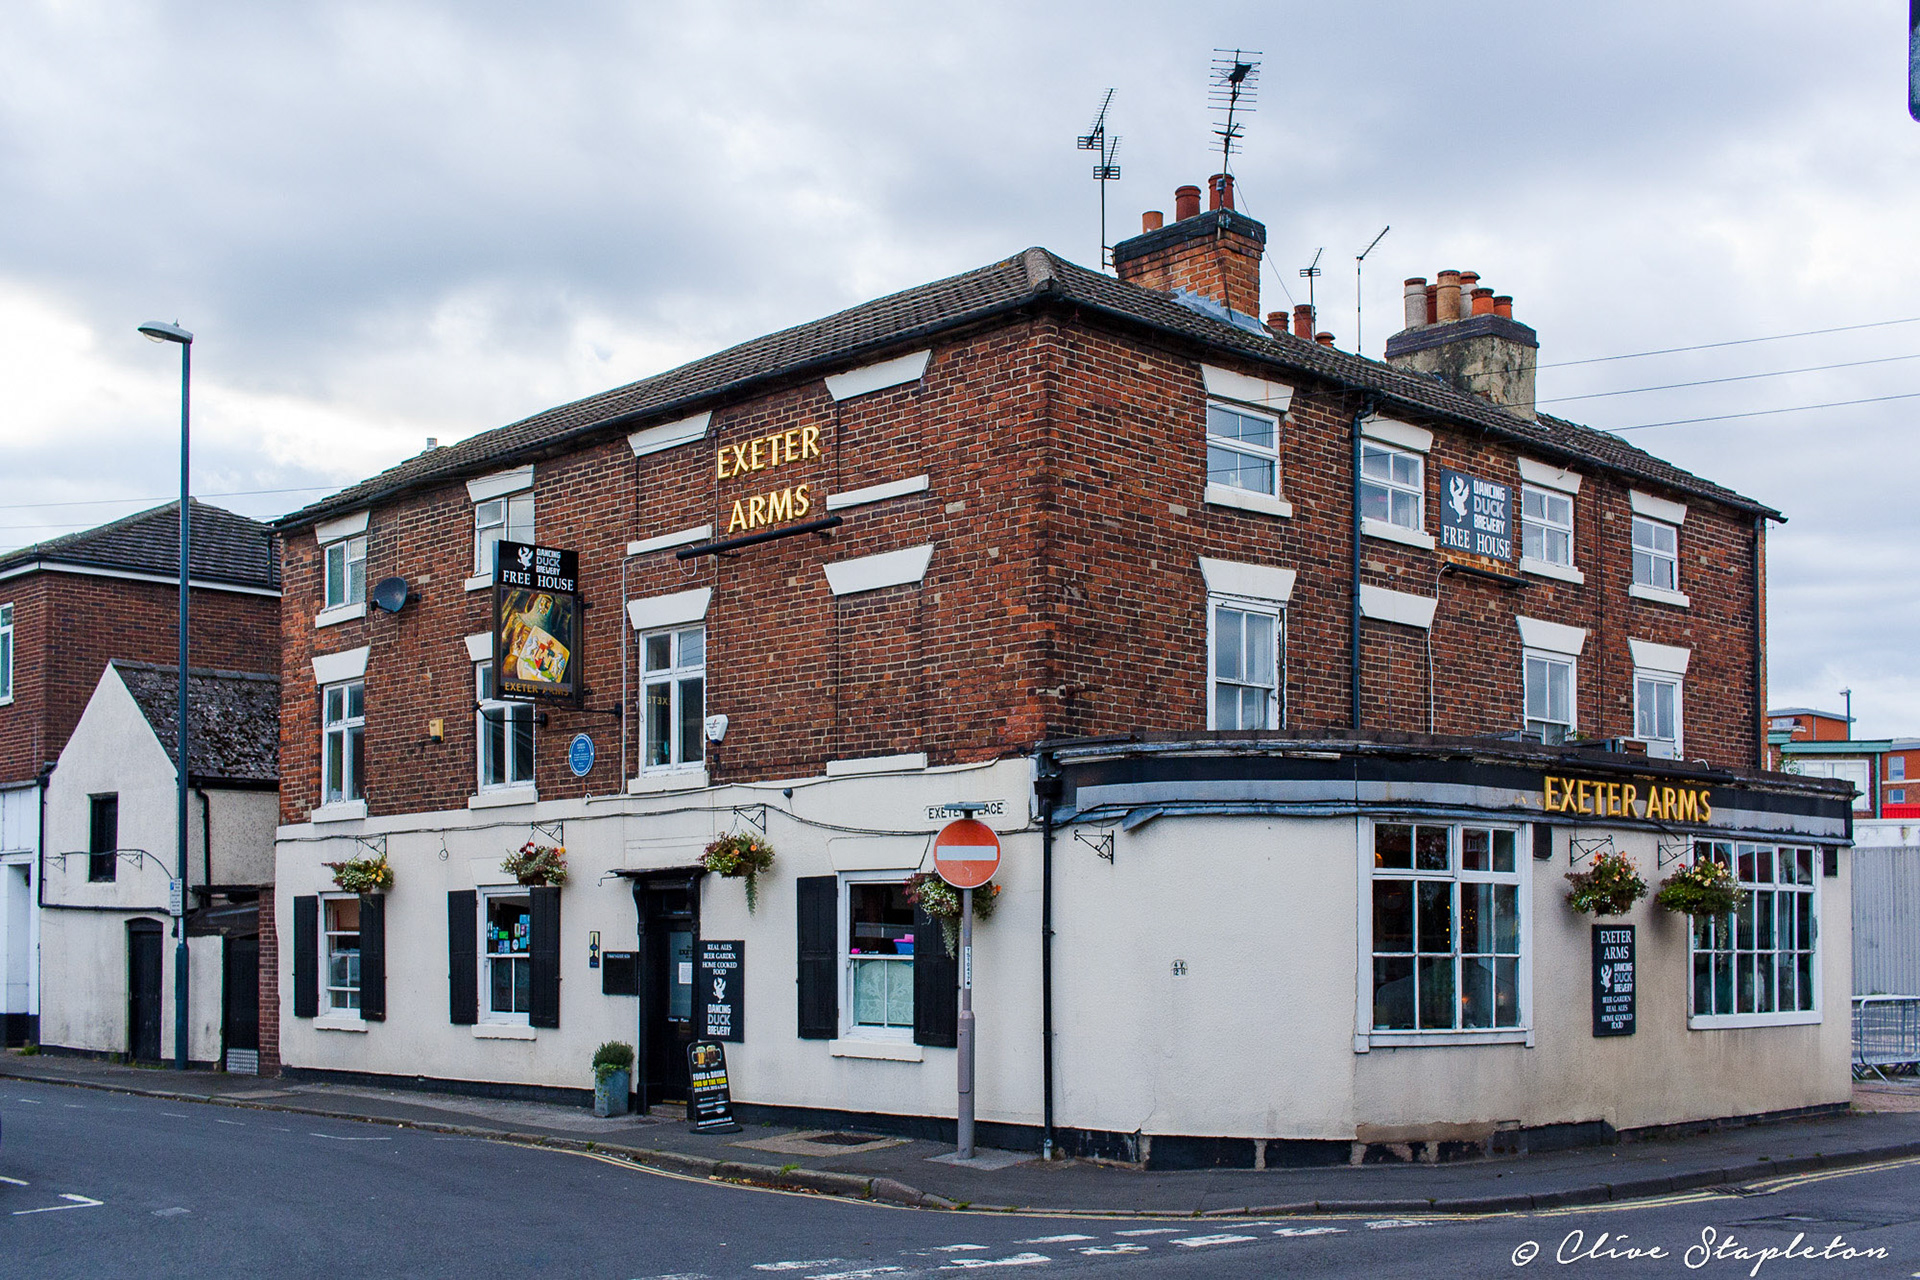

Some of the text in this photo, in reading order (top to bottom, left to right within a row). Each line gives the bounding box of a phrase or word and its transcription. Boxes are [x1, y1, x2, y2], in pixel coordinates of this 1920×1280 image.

[717, 426, 821, 479] EXETER
[1473, 480, 1506, 501] DANCING
[728, 484, 810, 533] ARMS
[1473, 495, 1506, 519] DUCK
[1473, 513, 1506, 534] BREWERY
[1443, 525, 1511, 559] FREE HOUSE
[536, 548, 561, 559] DANCING
[536, 556, 560, 567] DUCK
[536, 565, 560, 576] BREWERY
[503, 569, 574, 591] FREE HOUSE
[504, 681, 569, 697] EXETER ARMS
[1544, 775, 1712, 823] EXETER ARMS
[976, 802, 1004, 815] LACE
[1600, 930, 1632, 944] EXETER
[1603, 946, 1630, 960] ARMS
[702, 961, 738, 969] HOME COOKED
[1613, 963, 1633, 972] DANCING
[1614, 972, 1633, 983] DUCK
[1614, 983, 1633, 993] BREWERY
[1602, 995, 1632, 1004] BEER GARDEN
[707, 1004, 732, 1014] DANCING
[1606, 1005, 1617, 1013] REAL
[707, 1014, 731, 1026] DUCK
[1601, 1013, 1633, 1023] HOME COOKED
[707, 1025, 731, 1036] BREWERY
[1611, 1021, 1624, 1030] FOOD
[692, 1072, 706, 1080] FOOD
